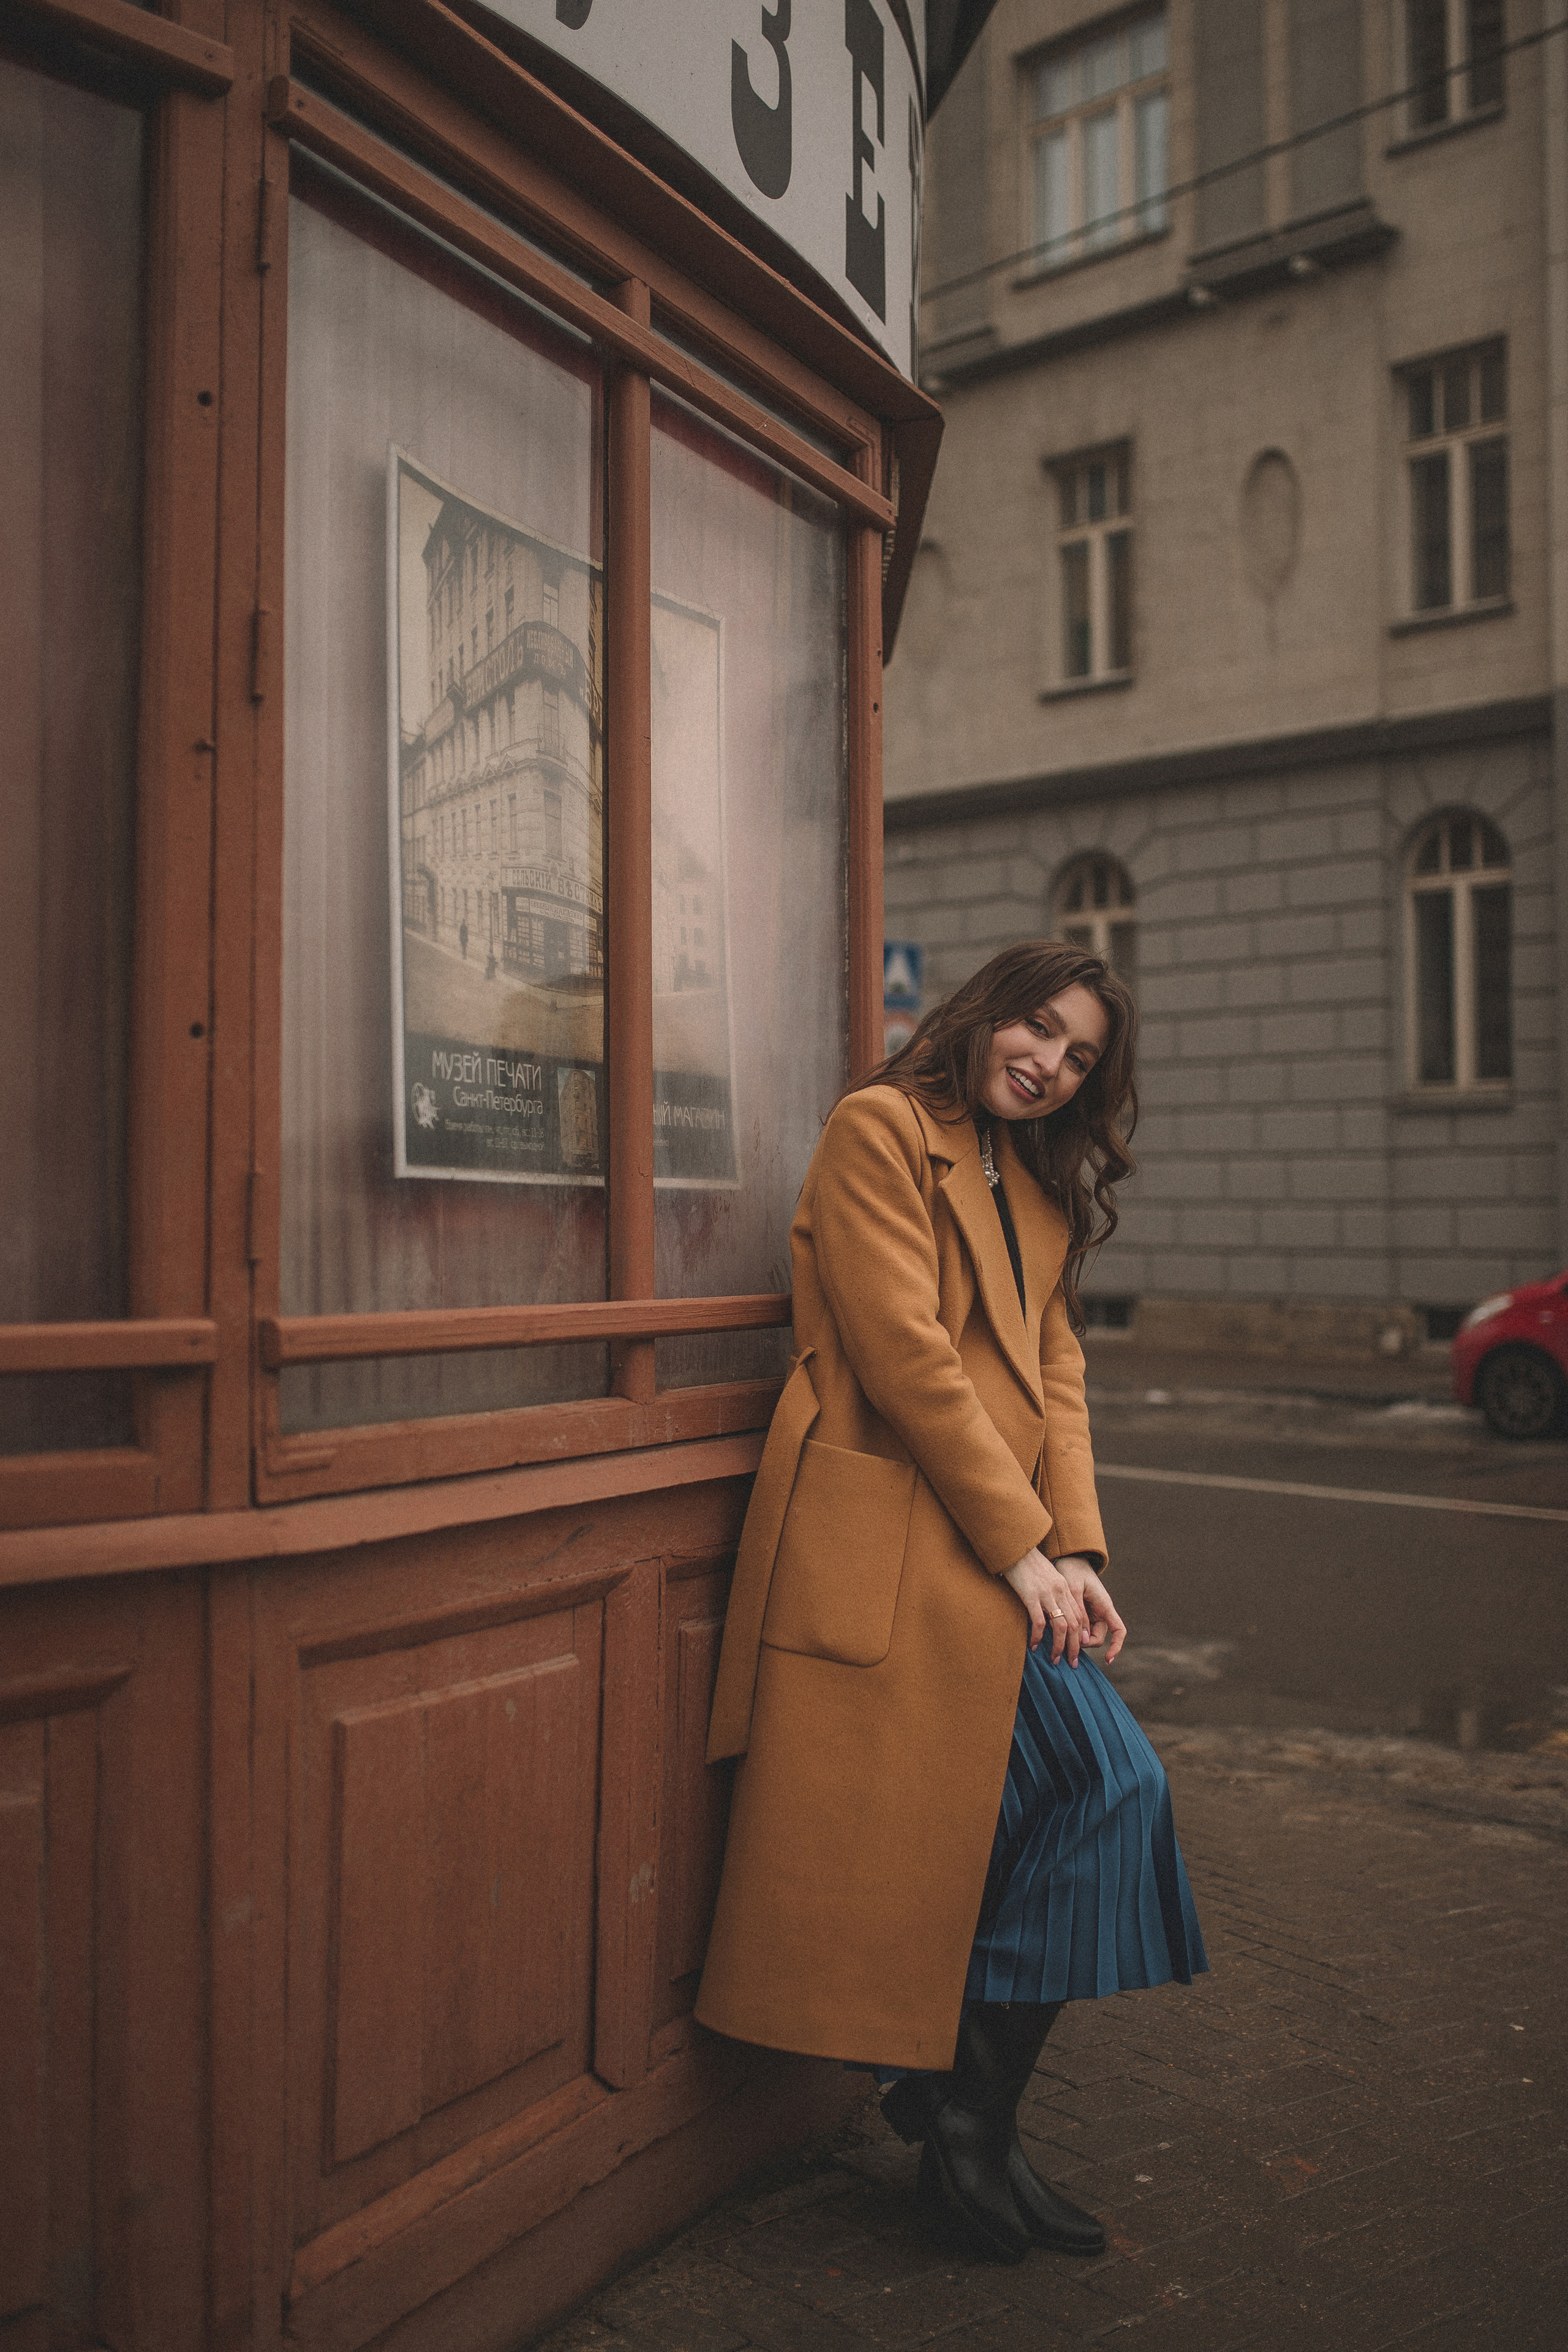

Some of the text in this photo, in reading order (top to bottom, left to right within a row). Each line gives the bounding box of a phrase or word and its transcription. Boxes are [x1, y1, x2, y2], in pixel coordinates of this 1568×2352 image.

[432, 1050, 542, 1091] МУЗЕЙ ПЕЧАТИ
[453, 1085, 543, 1118] Санкт-Петербурга
